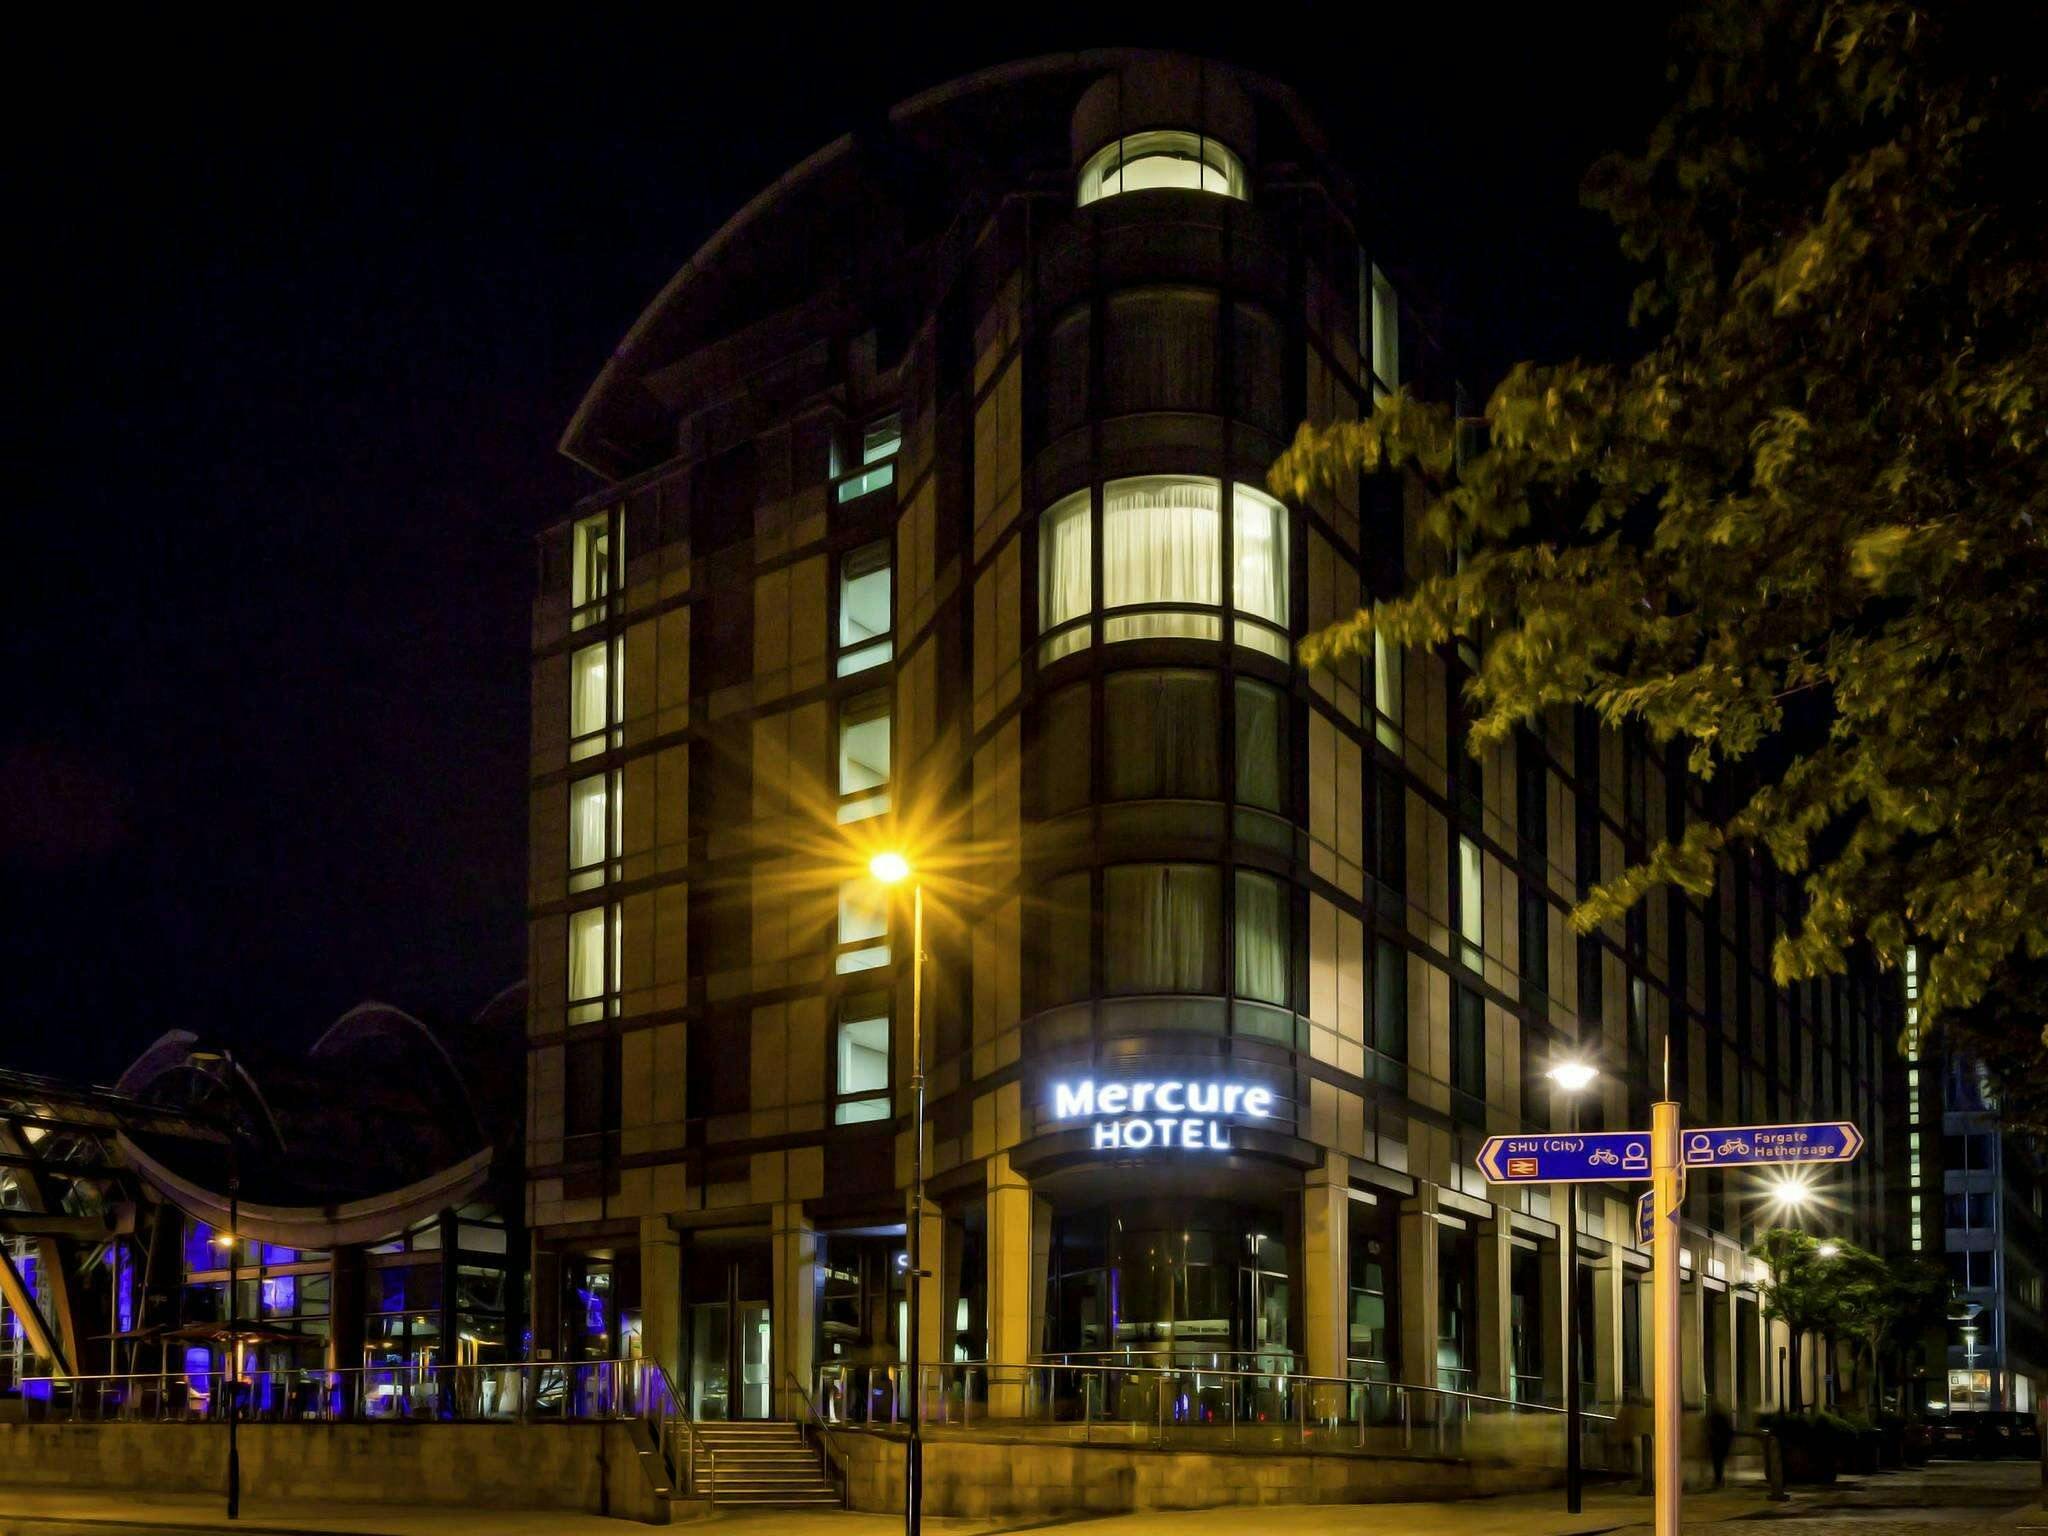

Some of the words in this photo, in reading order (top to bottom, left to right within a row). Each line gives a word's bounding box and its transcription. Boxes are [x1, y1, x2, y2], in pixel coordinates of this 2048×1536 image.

[1055, 1079, 1273, 1118] Mercure
[1092, 1118, 1232, 1150] HOTEL
[1754, 1131, 1808, 1144] Fargate
[1507, 1141, 1539, 1153] SHU
[1543, 1139, 1584, 1153] (City)
[1754, 1145, 1836, 1157] Hathersage
